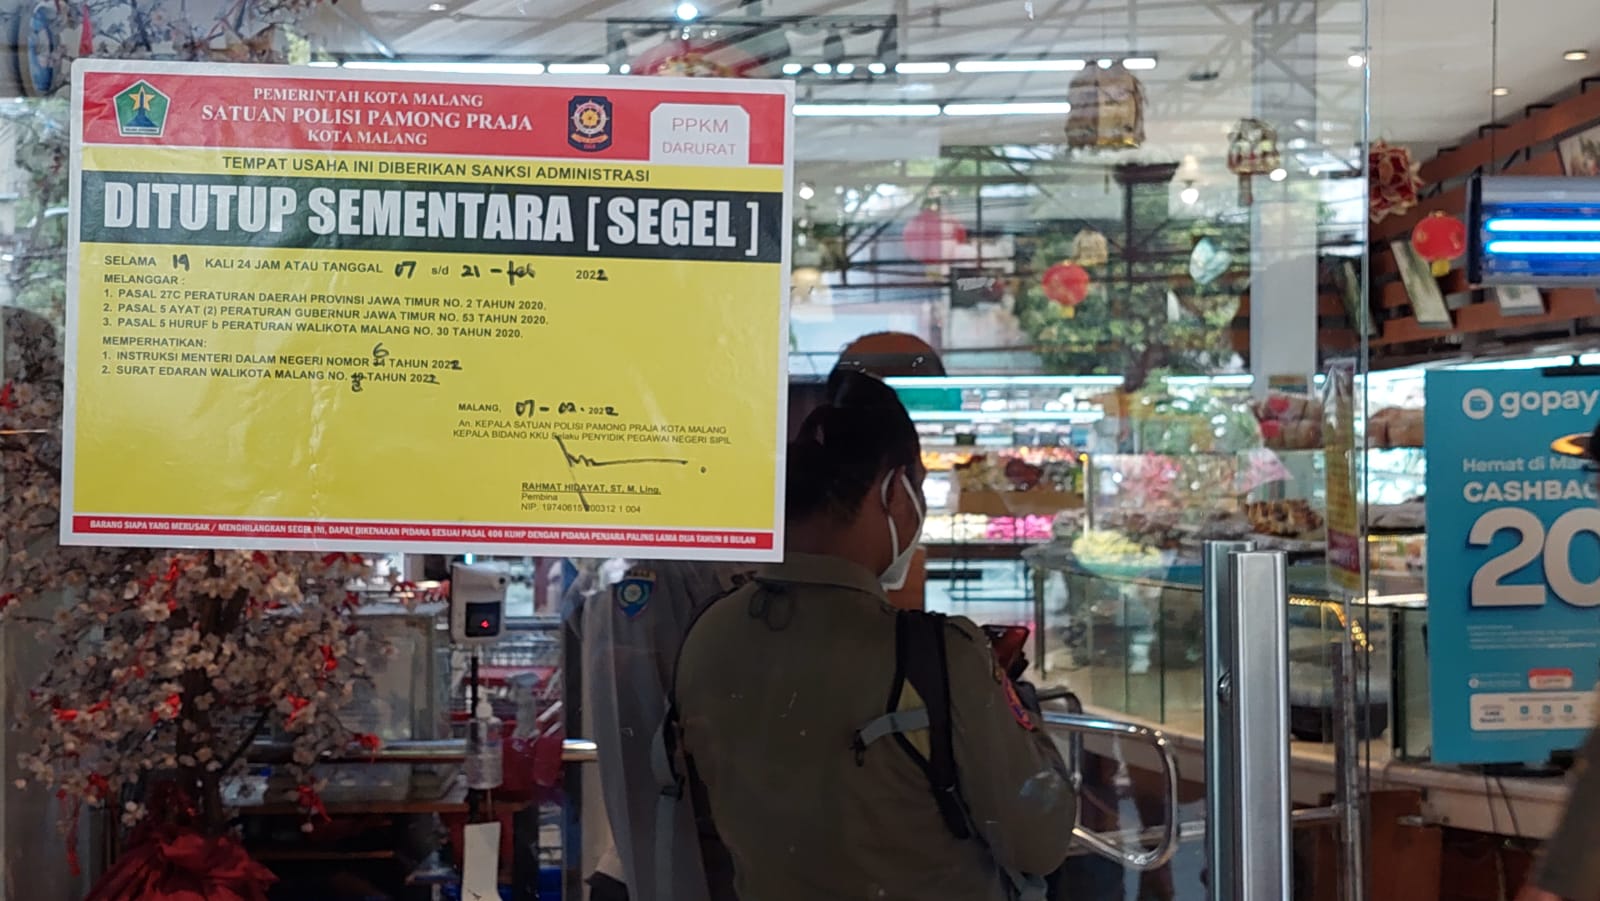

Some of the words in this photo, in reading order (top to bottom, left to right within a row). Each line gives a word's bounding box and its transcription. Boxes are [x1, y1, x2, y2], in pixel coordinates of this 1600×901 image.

[254, 87, 359, 103] PEMERINTAH
[364, 91, 408, 105] KOTA
[413, 92, 483, 108] MALANG
[202, 105, 286, 123] SATUAN
[293, 108, 361, 125] POLISI
[368, 110, 460, 129] PAMONG
[466, 114, 533, 131] PRAJA
[672, 117, 729, 133] PPKM
[307, 129, 351, 144] KOTA
[356, 131, 428, 146] MALANG
[662, 140, 737, 156] DARURAT
[222, 156, 287, 171] TEMPAT
[293, 157, 348, 173] USAHA
[353, 160, 374, 173] INI
[378, 160, 466, 176] DIBERIKAN
[471, 164, 531, 179] SANKSI
[535, 166, 650, 182] ADMINISTRASI
[103, 181, 297, 233] DITUTUP
[308, 186, 574, 242] SEMENTARA
[587, 196, 601, 252] [
[607, 197, 737, 248] SEGEL
[745, 201, 759, 257] ]
[104, 255, 157, 266] SELAMA
[205, 258, 234, 269] KALI
[237, 260, 251, 269] 24
[254, 260, 280, 270] JAM
[284, 261, 318, 271] ATAU
[322, 262, 383, 274] TANGGAL
[431, 265, 449, 276] s/d
[460, 265, 481, 278] 21
[104, 289, 113, 298] 1.
[118, 289, 157, 299] PASAL
[160, 290, 181, 299] 27C
[184, 291, 255, 302] PERATURAN
[259, 293, 307, 303] DAERAH
[310, 295, 364, 305] PROVINSI
[367, 296, 400, 306] JAWA
[404, 297, 440, 307] TIMUR
[443, 298, 463, 308] NO.
[466, 299, 473, 309] 2
[476, 299, 515, 309] TAHUN
[518, 300, 547, 311] 2020.
[103, 303, 113, 313] 2.
[118, 303, 157, 314] PASAL
[160, 305, 166, 314] 5
[169, 305, 200, 315] AYAT
[203, 305, 217, 317] (2)
[220, 306, 291, 317] PERATURAN
[295, 308, 360, 320] GUBERNUR
[363, 310, 397, 320] JAWA
[400, 311, 435, 321] TIMUR
[439, 312, 459, 322] NO.
[462, 313, 475, 322] 53
[478, 313, 517, 324] TAHUN
[520, 315, 549, 325] 2020.
[103, 317, 112, 327] 3.
[118, 317, 156, 328] PASAL
[159, 319, 166, 328] 5
[169, 319, 208, 330] HURUF
[212, 319, 218, 330] b
[222, 320, 292, 332] PERATURAN
[296, 322, 357, 333] WALIKOTA
[360, 325, 410, 335] MALANG
[413, 326, 433, 336] NO.
[437, 327, 449, 336] 30
[453, 327, 492, 338] TAHUN
[495, 328, 523, 339] 2020.
[102, 336, 207, 348] MEMPERHATIKAN:
[102, 351, 111, 361] 1.
[117, 351, 178, 362] INSTRUKSI
[181, 353, 233, 363] MENTERI
[236, 354, 276, 364] DALAM
[279, 355, 323, 366] NEGERI
[326, 357, 369, 367] NOMOR
[389, 359, 428, 369] TAHUN
[102, 365, 111, 375] 2.
[116, 365, 155, 376] SURAT
[159, 367, 207, 378] EDARAN
[210, 368, 271, 379] WALIKOTA
[275, 369, 324, 380] MALANG
[327, 371, 348, 381] NO.
[367, 372, 406, 382] TAHUN
[458, 403, 501, 413] MALANG,
[1500, 389, 1599, 419] gopay
[458, 419, 472, 428] An.
[475, 420, 511, 429] KEPALA
[514, 421, 551, 430] SATUAN
[554, 422, 583, 431] POLISI
[586, 423, 627, 432] PAMONG
[629, 424, 658, 433] PRAJA
[660, 425, 686, 433] KOTA
[688, 425, 727, 434] MALANG
[453, 429, 489, 438] KEPALA
[492, 430, 527, 439] BIDANG
[530, 431, 549, 440] KKU
[582, 433, 625, 442] PENYIDIK
[627, 434, 670, 443] PEGAWAI
[672, 435, 707, 444] NEGERI
[710, 436, 732, 445] SIPIL
[1463, 457, 1525, 472] Hemat
[1528, 455, 1545, 471] di
[521, 482, 561, 491] RAHMAT
[640, 486, 661, 495] Ling.
[521, 492, 558, 501] Pembina
[542, 504, 582, 512] 19740615
[625, 505, 641, 513] 004
[90, 519, 122, 529] BARANG
[124, 520, 148, 530] SIAPA
[149, 521, 169, 530] YANG
[171, 522, 210, 531] MERUSAK
[218, 523, 285, 533] MENGHILANGKAN
[328, 526, 354, 535] DAPAT
[355, 526, 400, 536] DIKENAKAN
[401, 528, 431, 537] PIDANA
[432, 529, 461, 538] SESUAI
[462, 529, 487, 538] PASAL
[527, 531, 560, 540] DENGAN
[561, 532, 591, 541] PIDANA
[592, 532, 625, 541] PENJARA
[626, 533, 654, 542] PALING
[655, 534, 677, 542] LAMA
[679, 534, 695, 543] DUA
[696, 535, 722, 544] TAHUN
[730, 536, 757, 545] BULAN
[1467, 507, 1600, 608] 20
